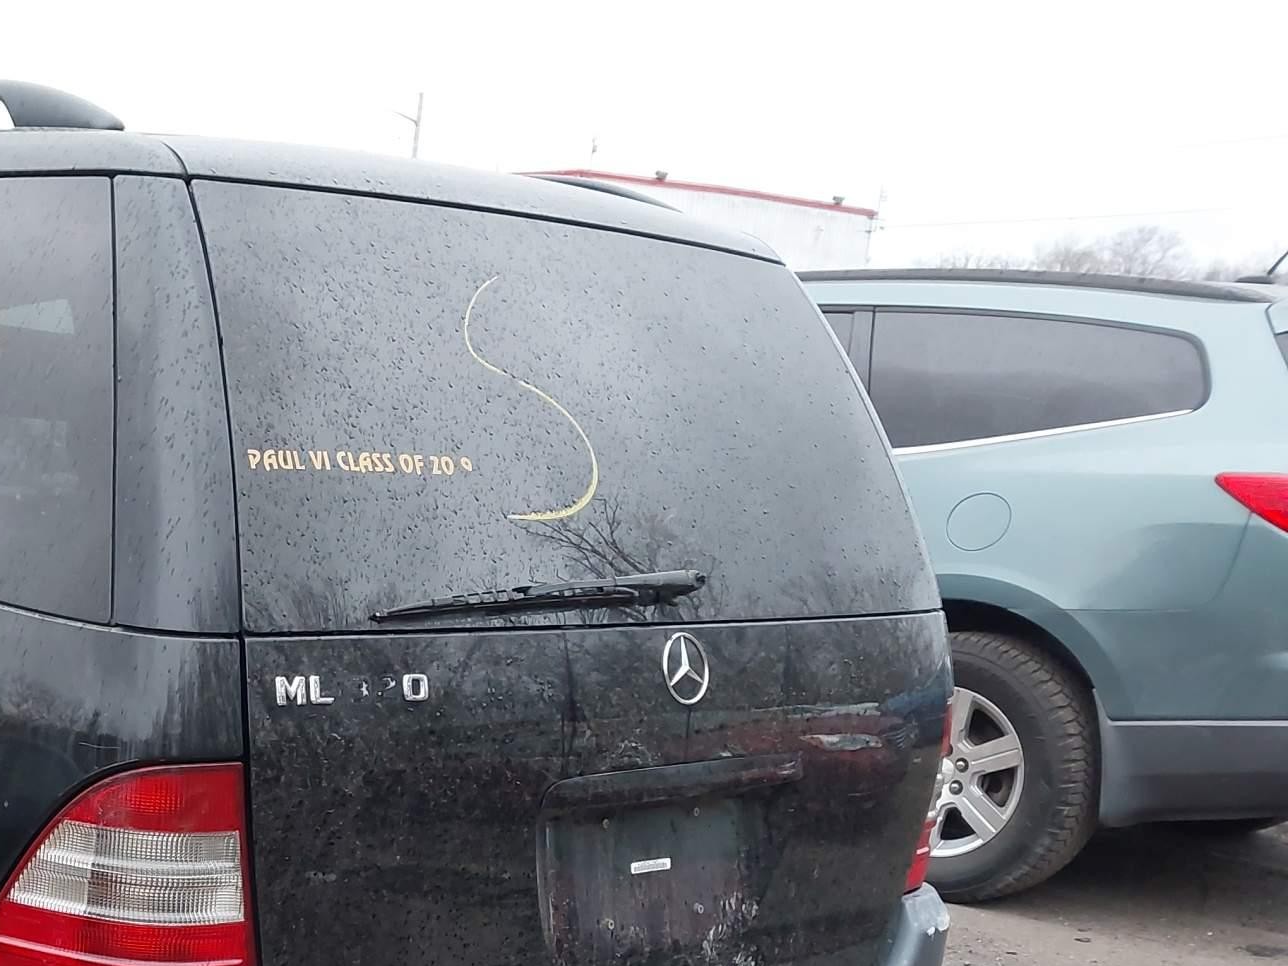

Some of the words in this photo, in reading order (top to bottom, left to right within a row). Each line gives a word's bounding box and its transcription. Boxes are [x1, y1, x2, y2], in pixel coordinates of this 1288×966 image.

[247, 449, 306, 472] PAUL
[307, 450, 331, 471] VI
[336, 450, 395, 474] CLASS
[399, 453, 424, 475] OF
[275, 674, 335, 706] ML
